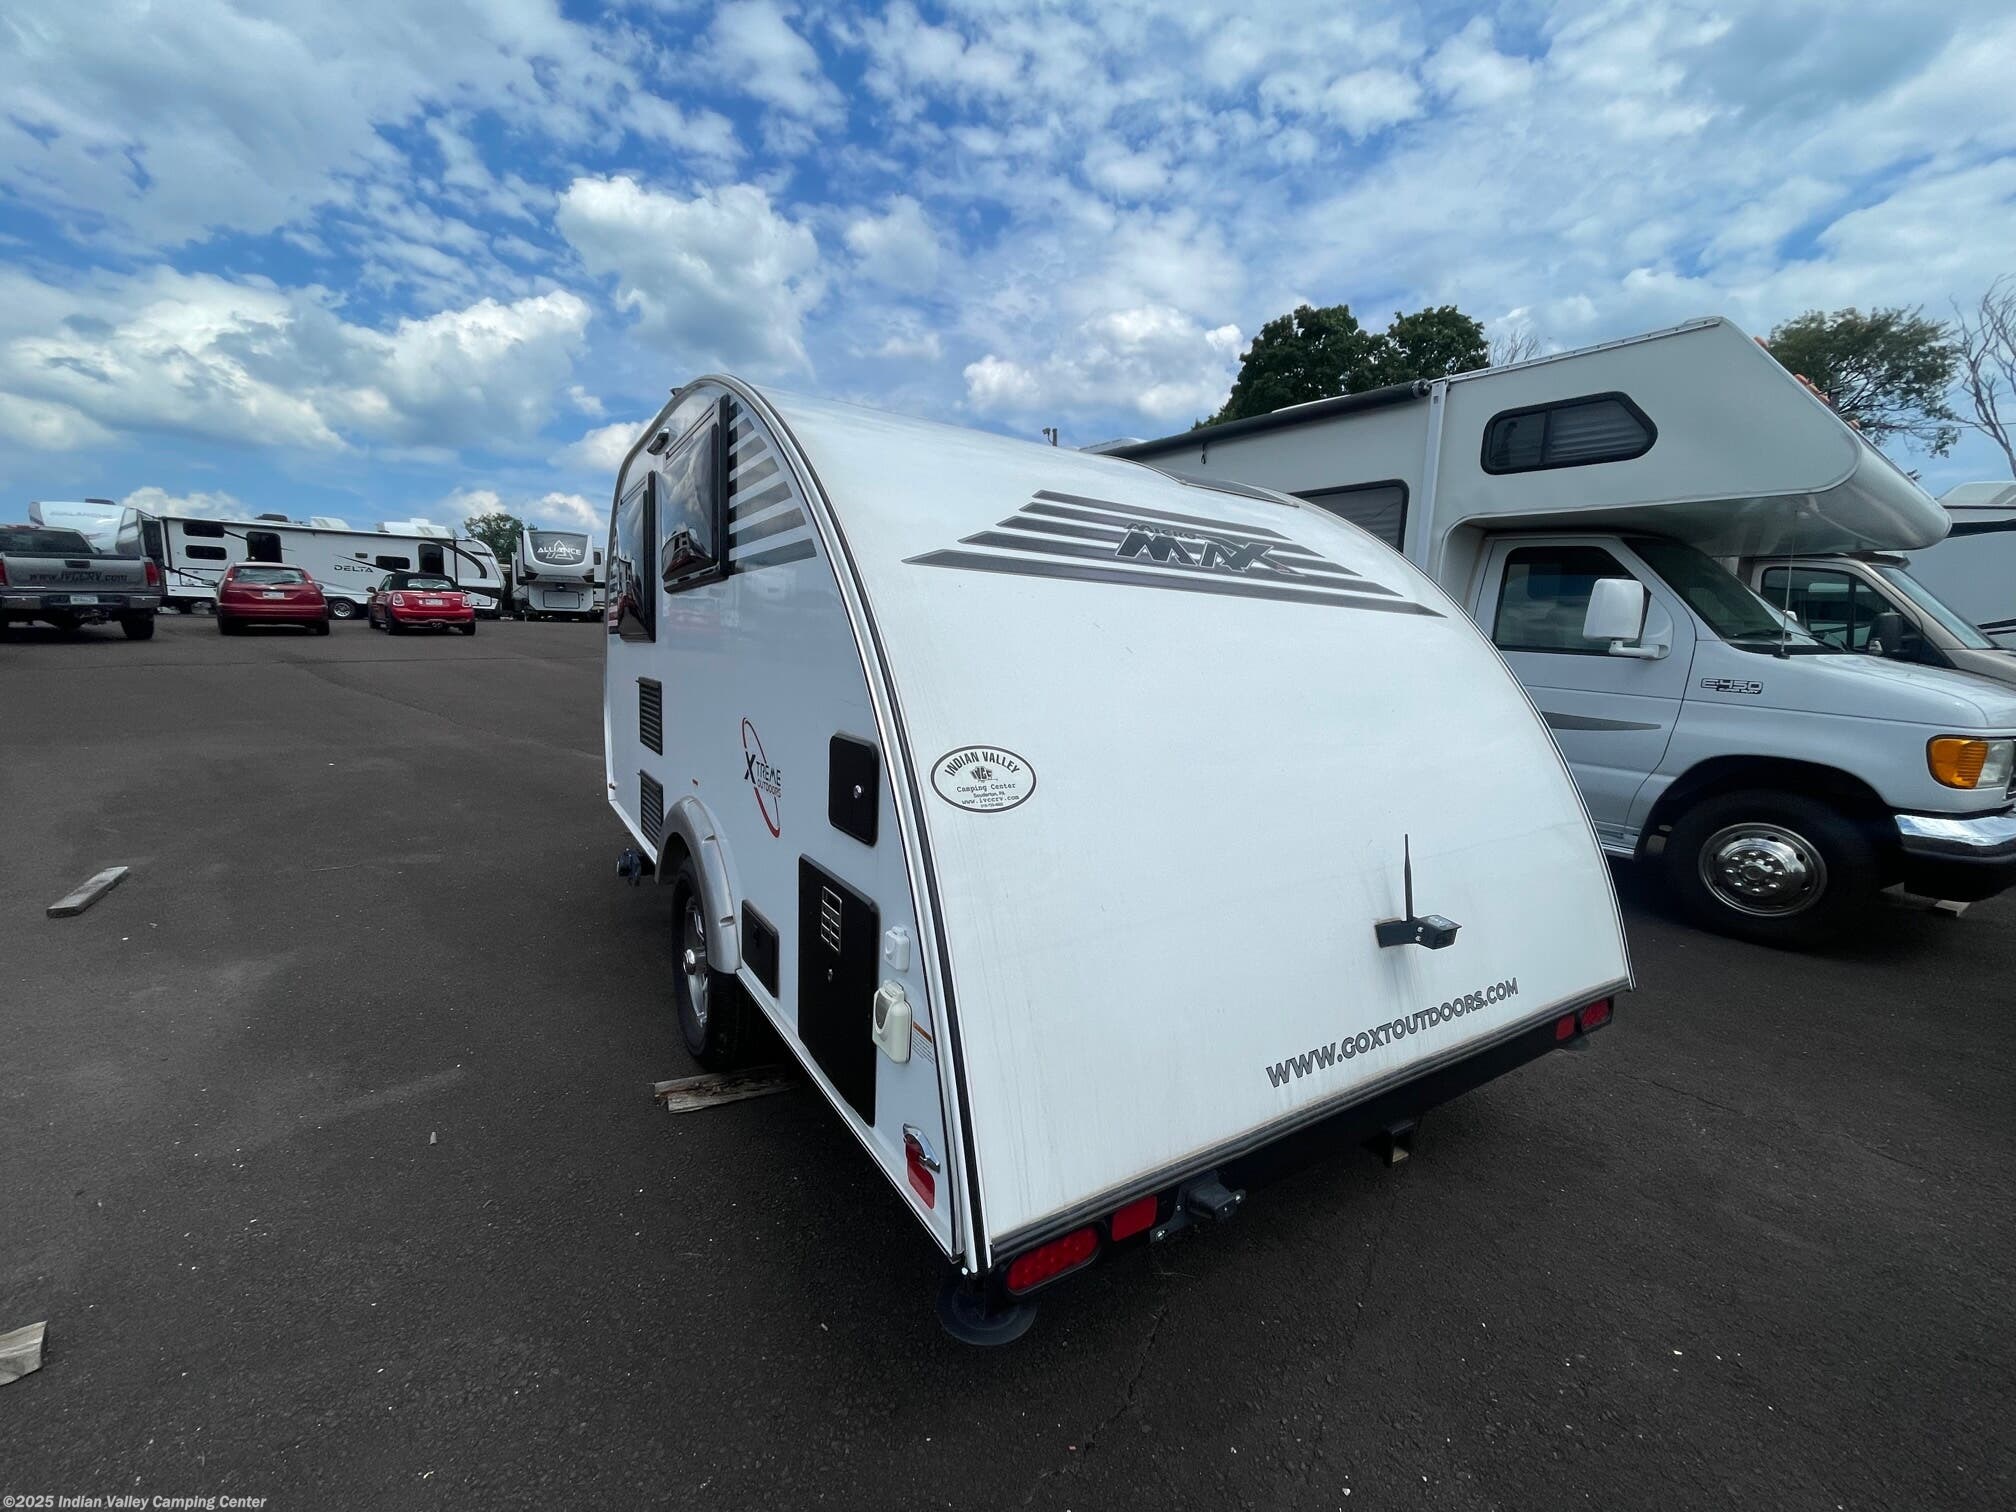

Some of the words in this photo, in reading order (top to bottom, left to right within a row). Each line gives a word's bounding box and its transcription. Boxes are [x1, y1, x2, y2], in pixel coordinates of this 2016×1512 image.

[537, 546, 582, 556] ALLIANCE
[333, 564, 374, 573] DELTA
[744, 751, 782, 787] XTREME
[944, 751, 980, 777] INDIAN
[981, 751, 1021, 774] VALLEY
[956, 785, 988, 793] Camping
[961, 795, 1020, 805] www.ivccrv.com
[1265, 977, 1519, 1088] WWW.GOXTOUTDOORS.COM
